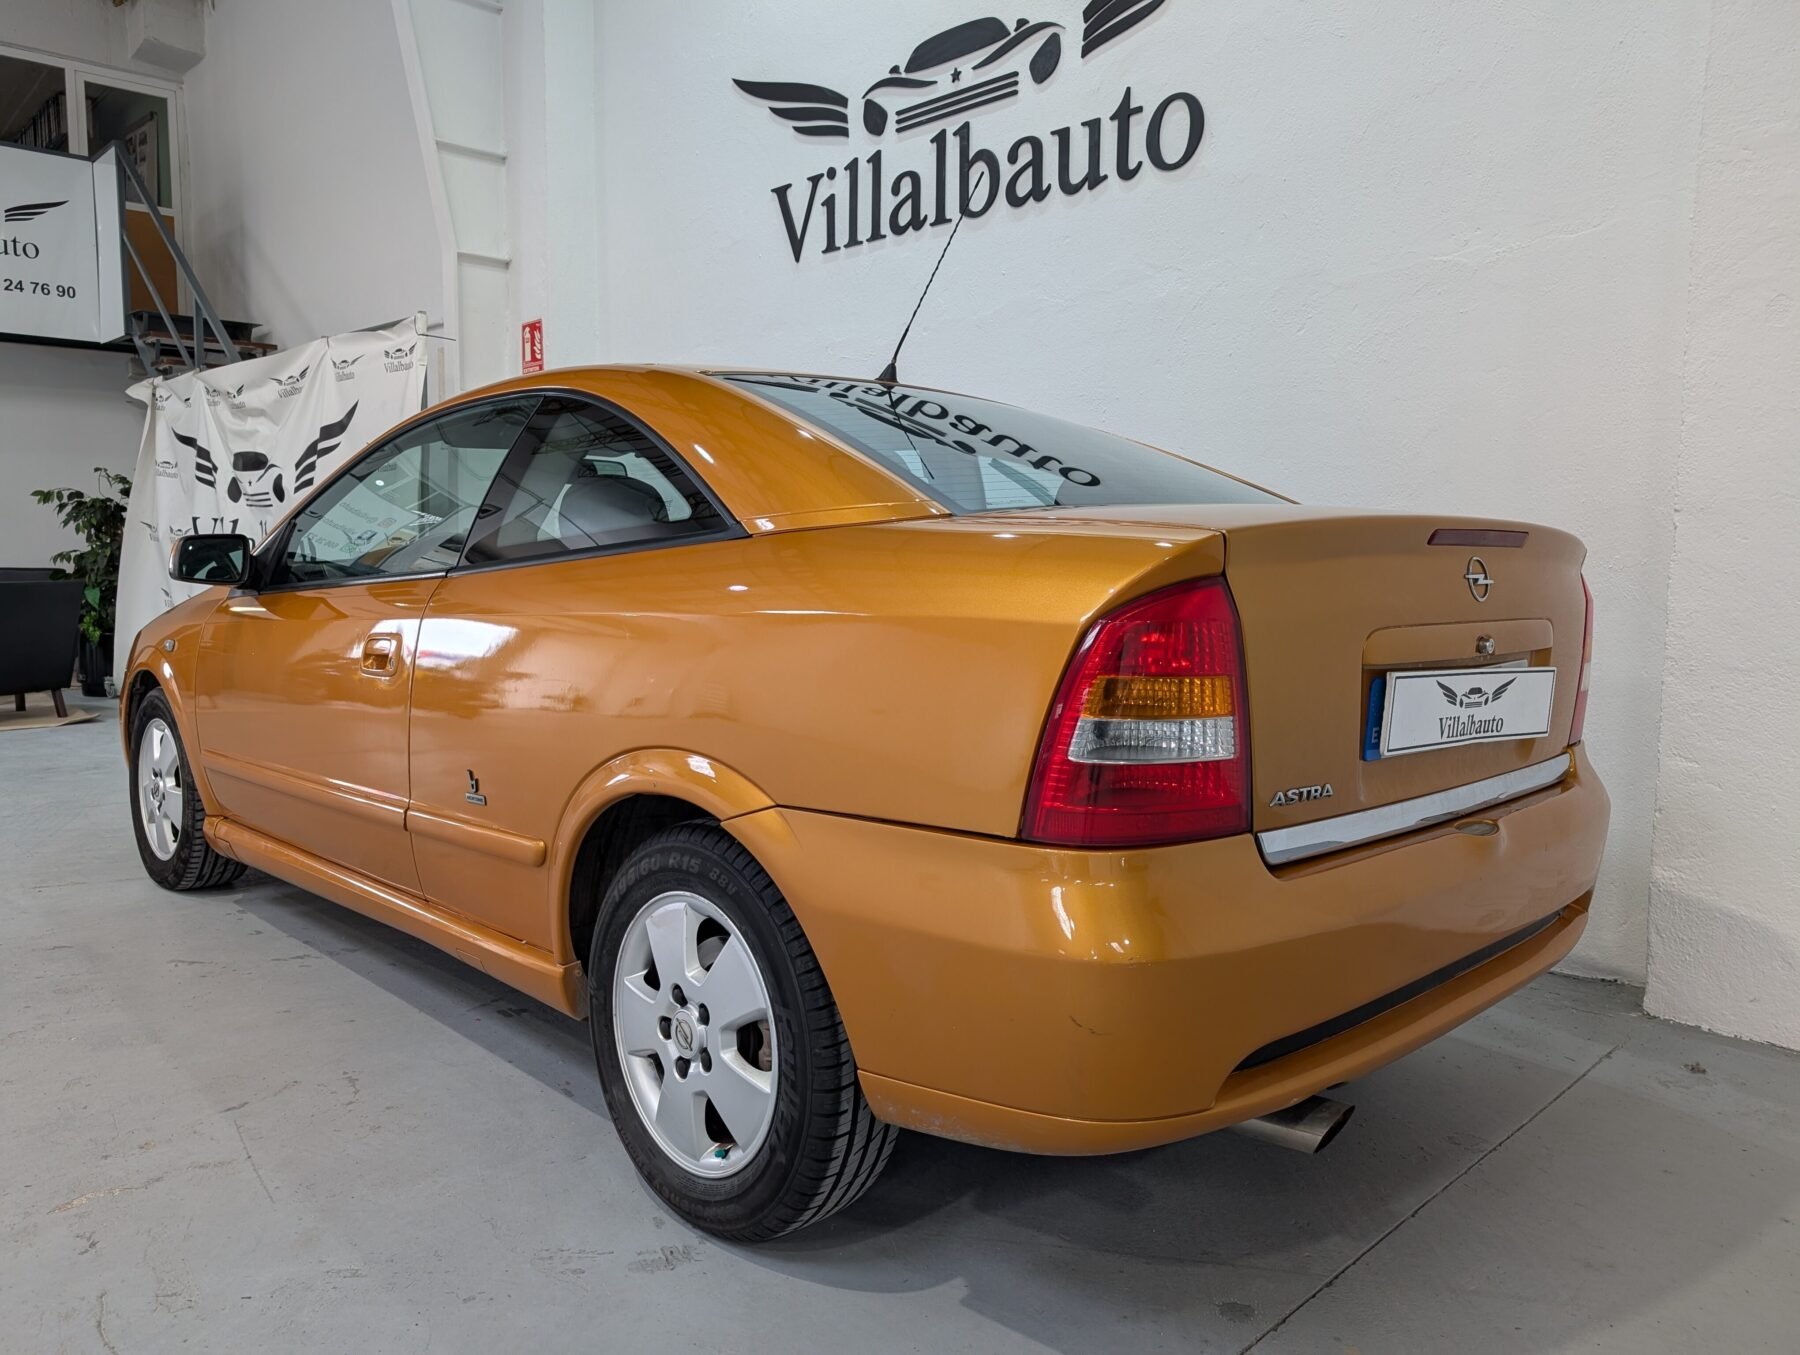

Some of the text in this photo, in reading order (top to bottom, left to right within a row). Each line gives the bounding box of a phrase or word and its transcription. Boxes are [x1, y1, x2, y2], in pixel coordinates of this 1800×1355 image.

[771, 86, 1205, 263] Villalbauto
[3, 278, 76, 299] 24 76 90
[1371, 727, 1380, 744] E
[1438, 714, 1504, 740] Villalbauto
[1269, 783, 1334, 807] ASTRA
[668, 852, 702, 874] R15
